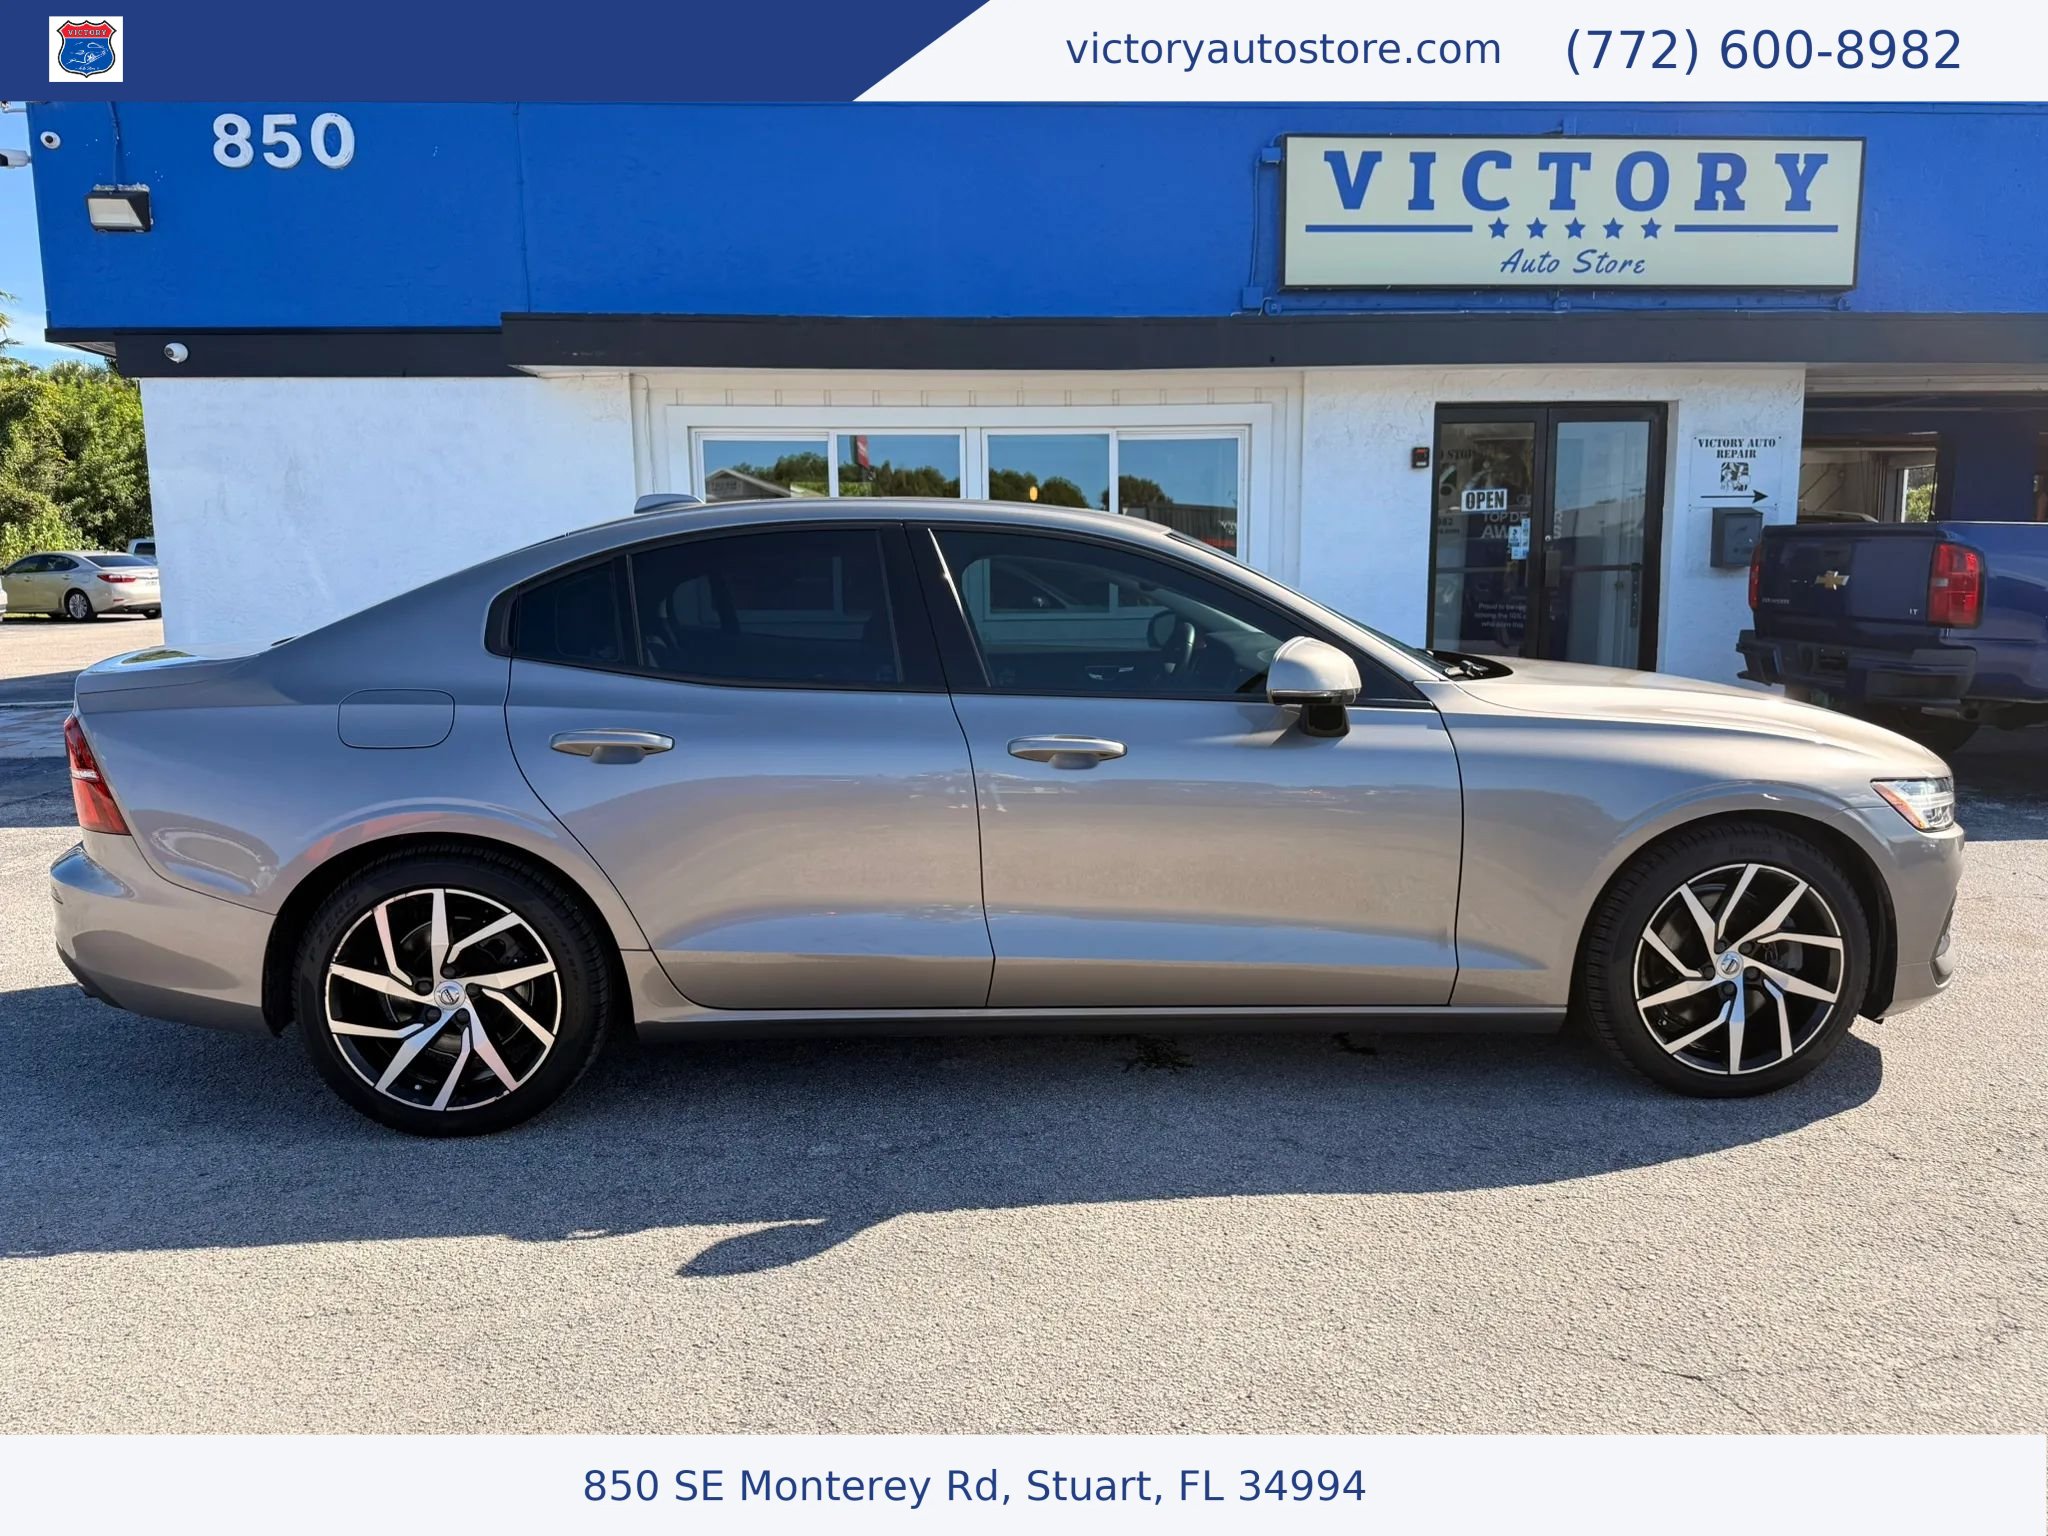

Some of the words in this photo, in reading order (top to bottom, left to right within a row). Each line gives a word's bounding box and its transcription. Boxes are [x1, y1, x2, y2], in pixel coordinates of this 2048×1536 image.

[212, 113, 356, 169] 850
[1323, 150, 1829, 212] VICTORY
[1500, 248, 1560, 274] Auto
[1572, 248, 1646, 275] Store
[1698, 438, 1744, 448] VICTORY
[1747, 438, 1776, 448] AUTO
[1716, 449, 1757, 459] REPAIR
[1465, 490, 1505, 510] OPEN
